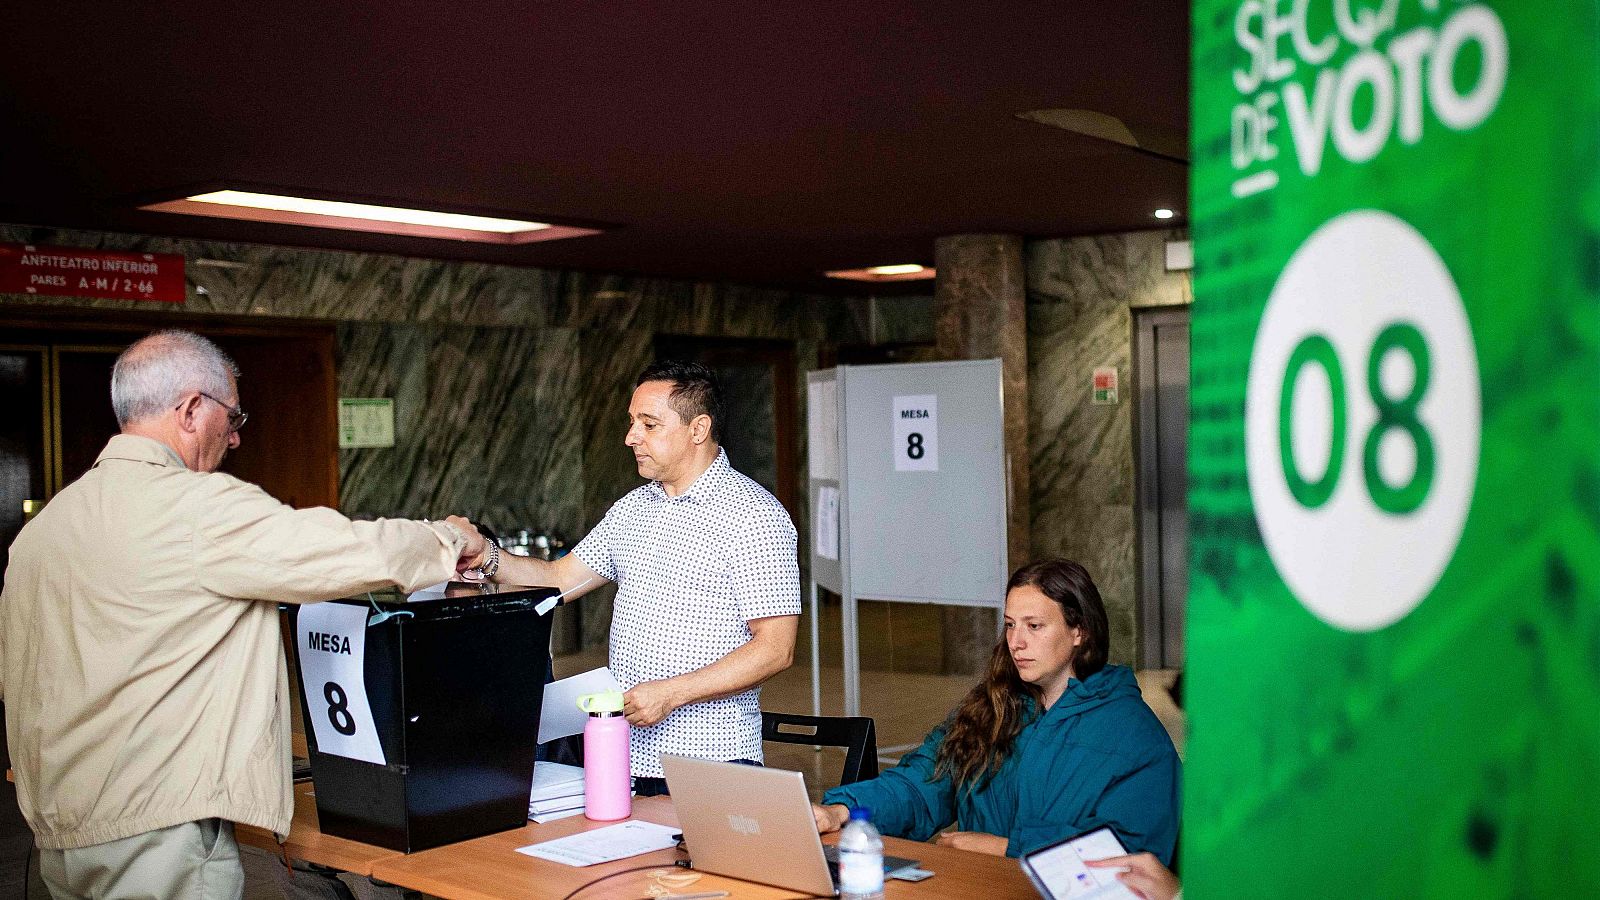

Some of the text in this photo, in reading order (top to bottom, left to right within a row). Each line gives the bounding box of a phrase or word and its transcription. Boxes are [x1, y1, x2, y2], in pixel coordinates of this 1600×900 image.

[1232, 0, 1440, 95] SECÇ
[1231, 4, 1508, 177] DE VOTO
[21, 255, 159, 275] ANFITEATRO INFERIOR
[31, 274, 66, 287] PARES
[901, 409, 929, 419] MESA
[1278, 322, 1437, 517] 08
[907, 432, 925, 460] 8
[308, 631, 351, 655] MESA
[323, 681, 356, 736] 8
